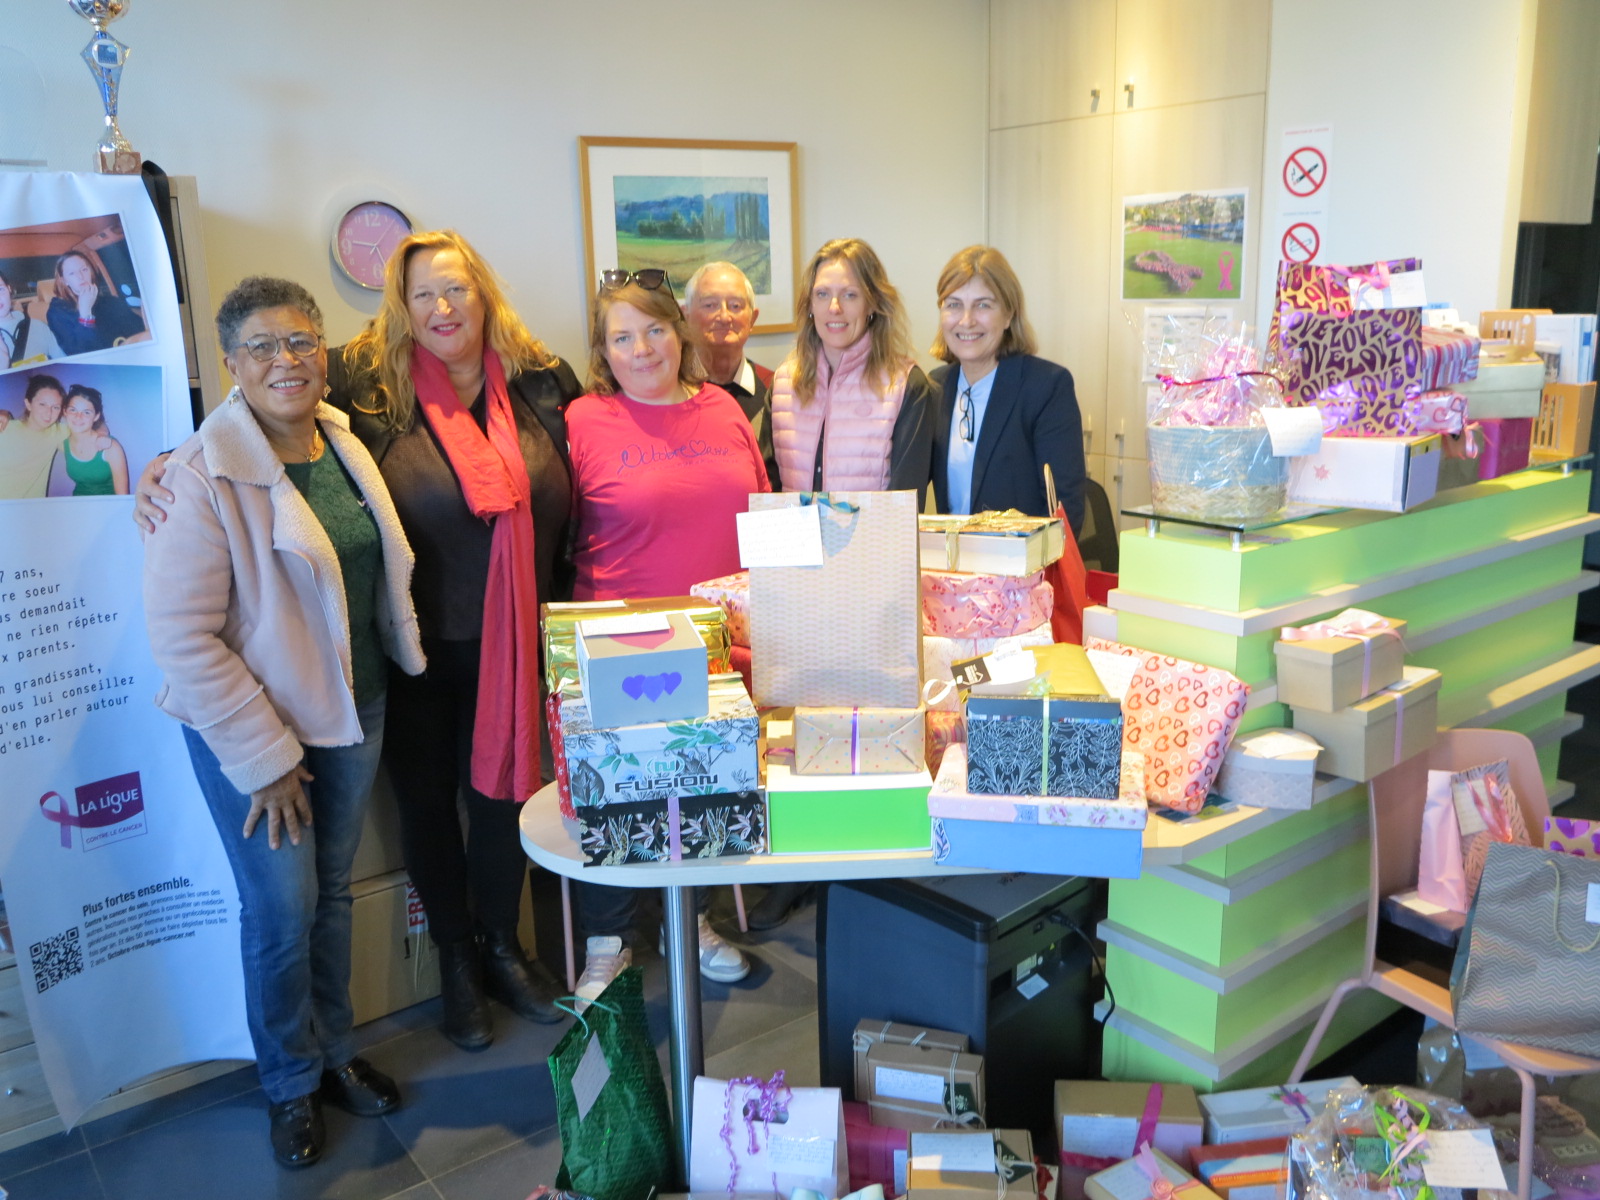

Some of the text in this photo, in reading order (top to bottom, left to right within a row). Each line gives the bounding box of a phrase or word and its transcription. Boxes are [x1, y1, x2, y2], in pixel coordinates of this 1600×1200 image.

[14, 568, 43, 580] ans,
[25, 584, 61, 598] soeur
[20, 597, 86, 620] demandait
[7, 612, 119, 642] ne rien répéter
[18, 641, 76, 662] parents.
[14, 664, 102, 694] grandissant,
[33, 692, 54, 708] lui
[62, 676, 134, 700] conseillez
[35, 706, 78, 728] parler
[86, 694, 129, 712] autour
[0, 734, 52, 755] d'elle.
[614, 774, 718, 794] FUSION
[81, 800, 98, 815] LA
[86, 823, 142, 844] CONTRE LE CANCER
[82, 876, 193, 917] Plus fortes ensemble.
[109, 908, 127, 918] cancer
